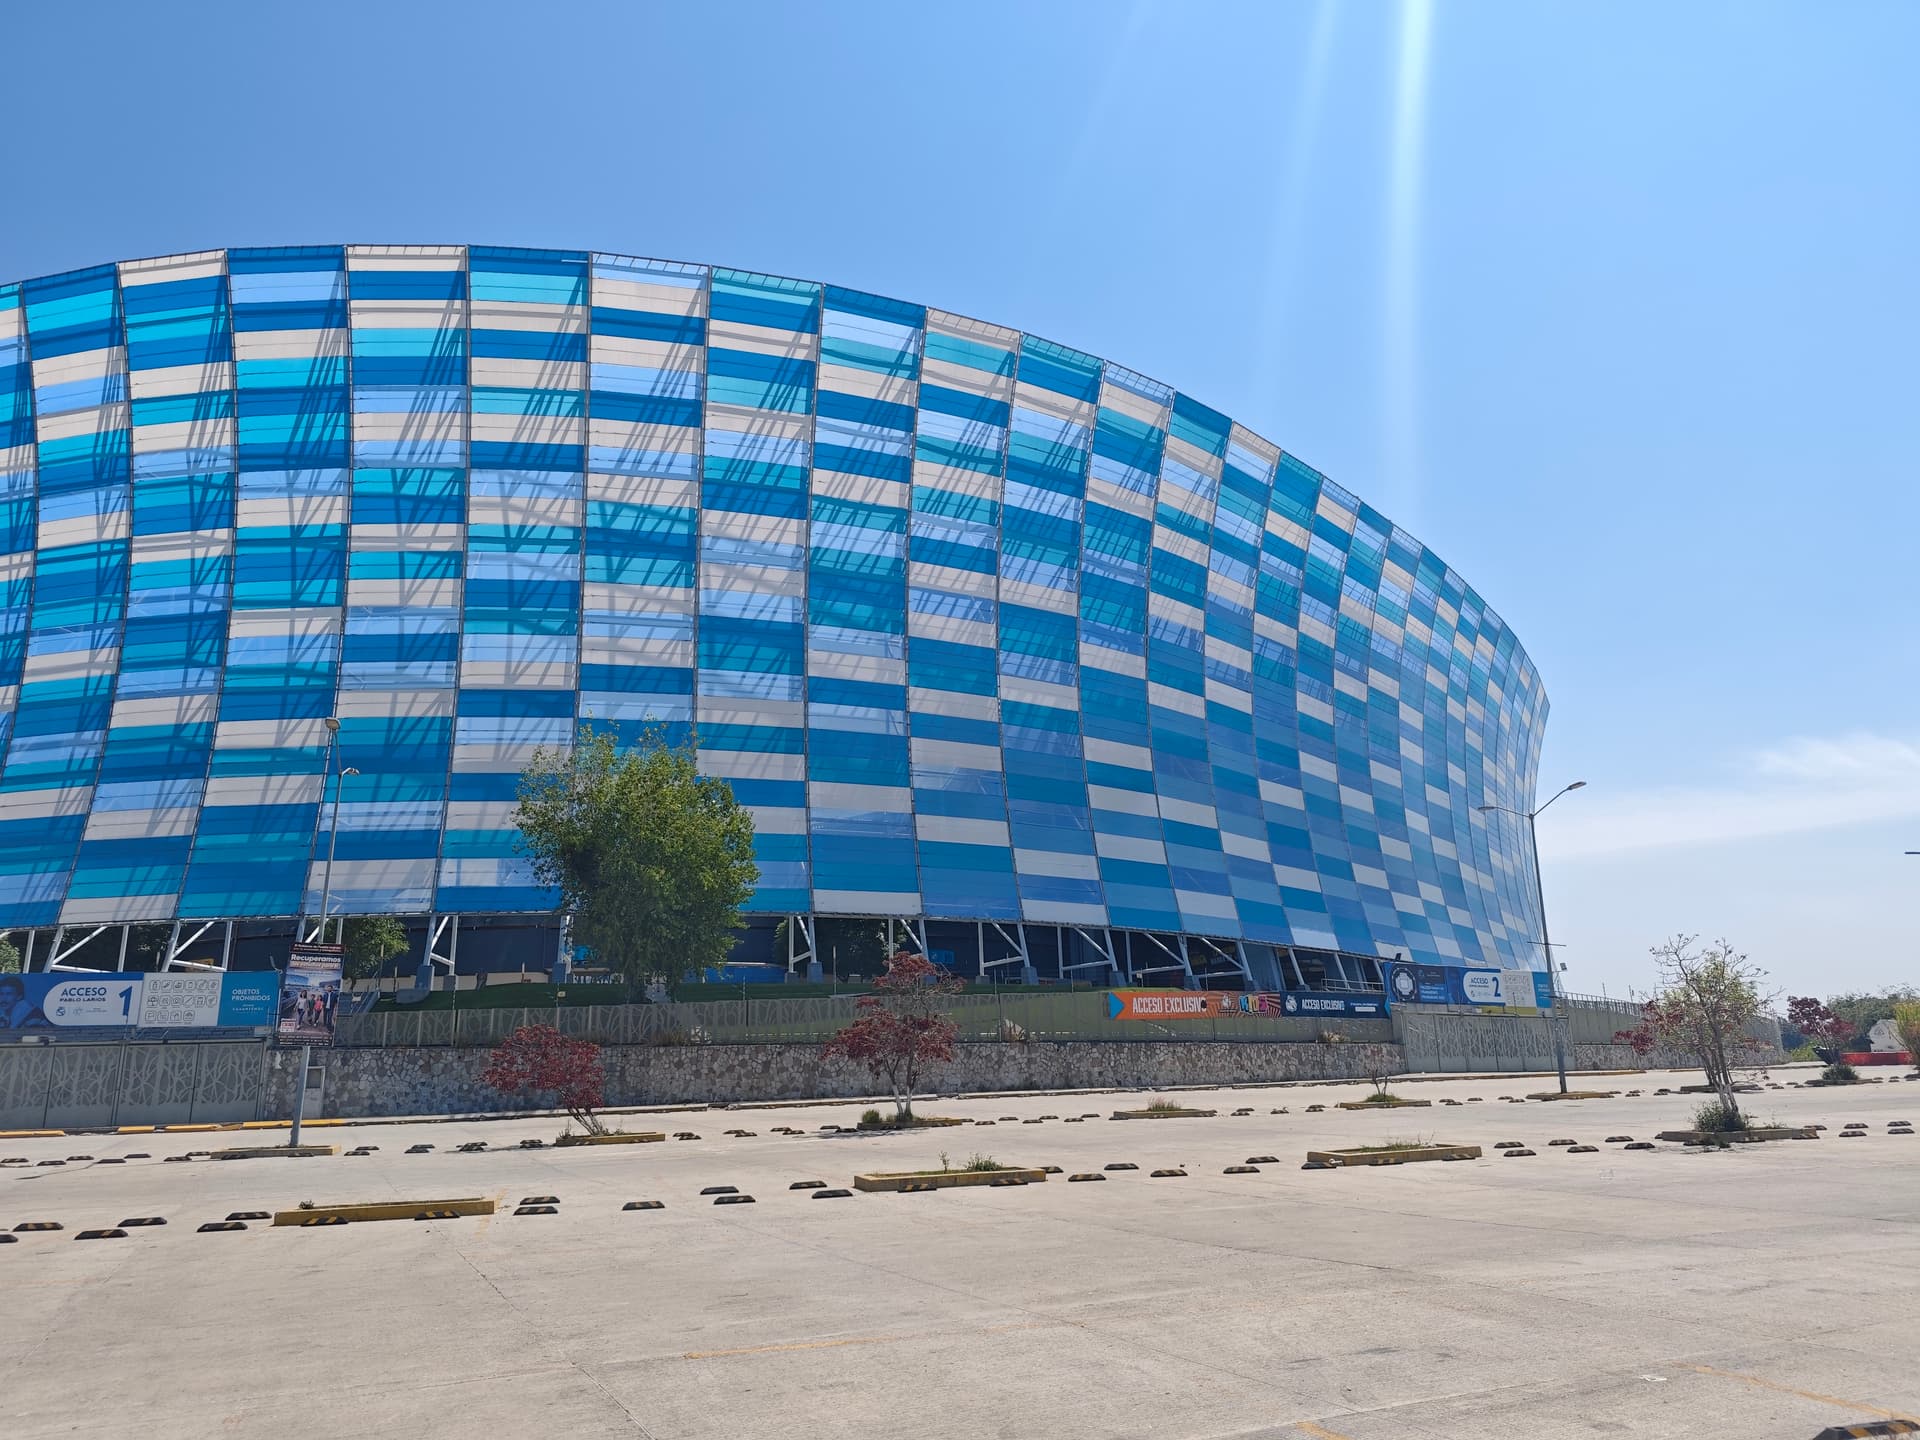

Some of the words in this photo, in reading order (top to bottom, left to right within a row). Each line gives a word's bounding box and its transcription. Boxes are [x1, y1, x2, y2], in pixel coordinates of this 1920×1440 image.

[291, 954, 341, 963] Recuperamos
[61, 987, 107, 997] ACCESO
[1492, 976, 1501, 997] 2
[119, 986, 133, 1017] 1
[1132, 997, 1163, 1014] ACCESO
[1301, 999, 1320, 1010] ACCESO
